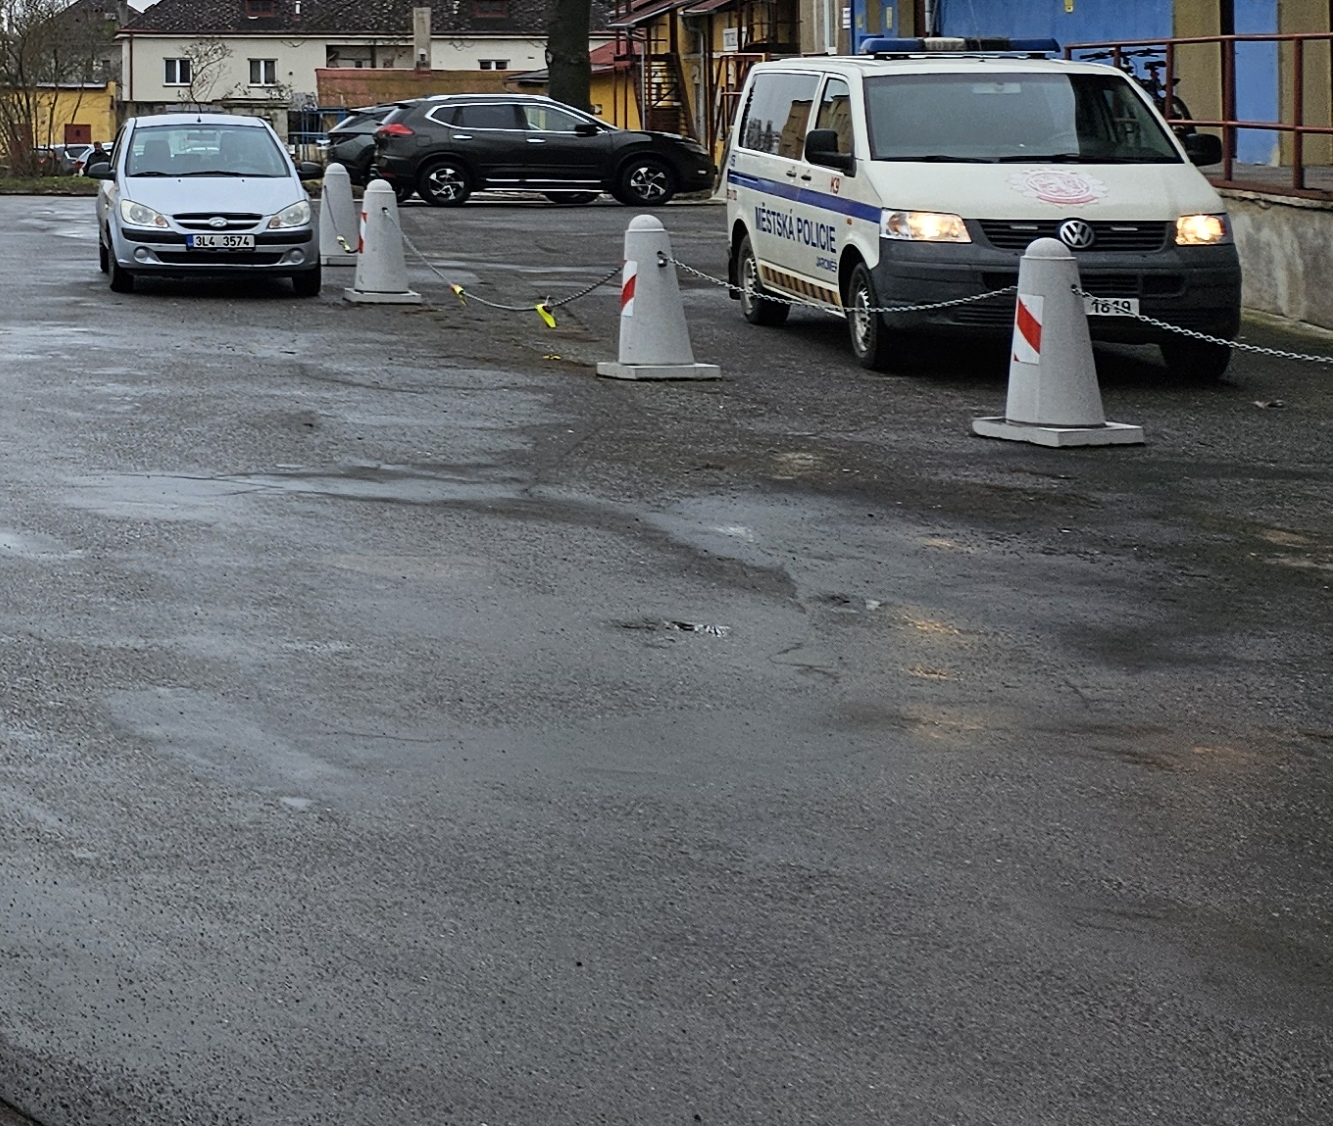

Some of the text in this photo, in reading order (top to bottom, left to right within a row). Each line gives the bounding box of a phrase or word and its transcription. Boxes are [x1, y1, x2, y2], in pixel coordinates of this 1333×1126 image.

[830, 177, 840, 194] K9
[754, 202, 837, 254] MĚSTSKÁ POLICIE
[195, 236, 250, 247] 3L4 3574
